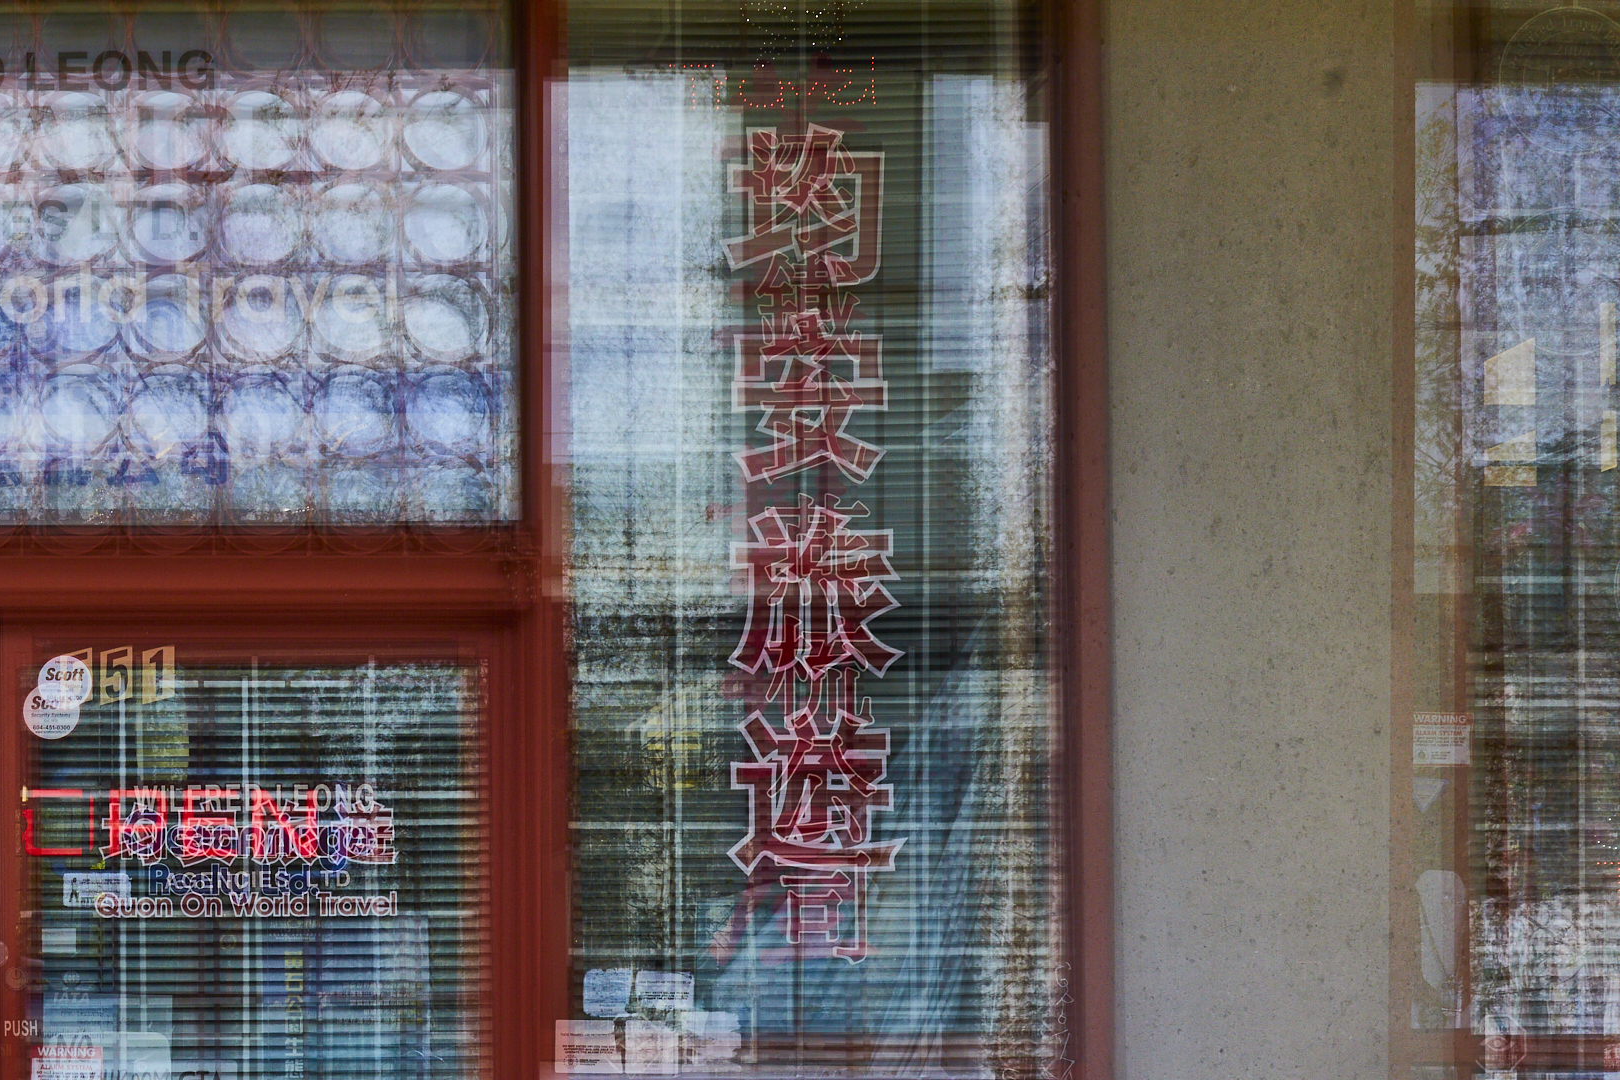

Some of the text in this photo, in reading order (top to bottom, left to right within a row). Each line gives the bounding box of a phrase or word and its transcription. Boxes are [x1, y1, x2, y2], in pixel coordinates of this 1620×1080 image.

[27, 49, 217, 93] LEONG
[667, 55, 878, 109] Travel
[176, 260, 401, 327] Travel
[45, 667, 85, 682] Scott
[1412, 714, 1467, 724] WARNING
[1415, 729, 1438, 737] ALARM
[134, 783, 375, 813] WILFRED LEONG
[94, 890, 398, 918] Quon On World Travel
[52, 992, 90, 1004] IATA
[4, 1019, 38, 1038] PUSH
[37, 1046, 96, 1058] WARNING
[40, 1063, 93, 1071] ALARM SYSTEM
